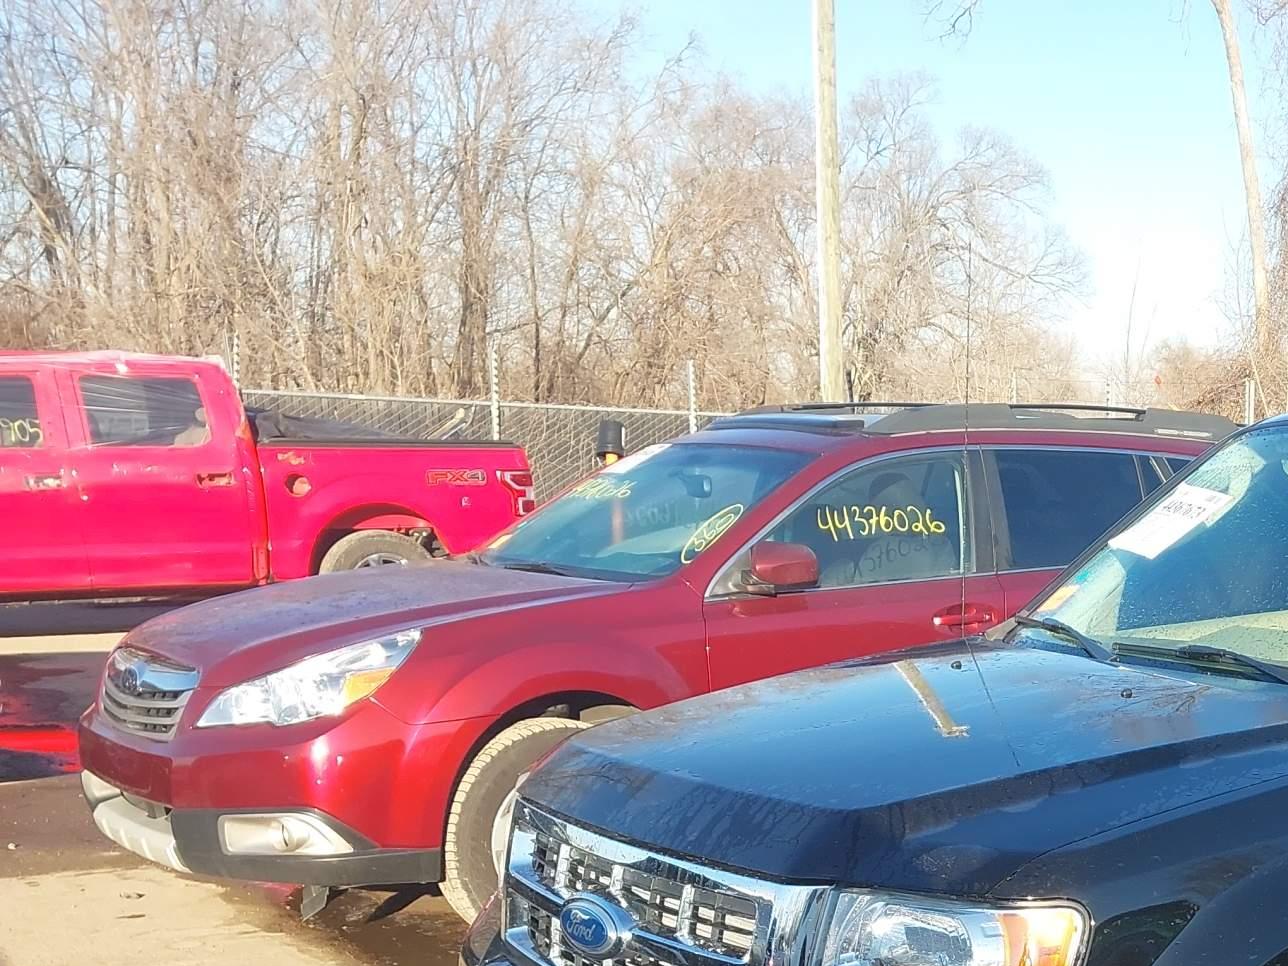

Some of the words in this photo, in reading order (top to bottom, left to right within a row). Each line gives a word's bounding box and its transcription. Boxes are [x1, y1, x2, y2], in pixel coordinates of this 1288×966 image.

[427, 469, 486, 485] FX4
[817, 505, 945, 541] 44376026
[566, 909, 594, 941] Ford
